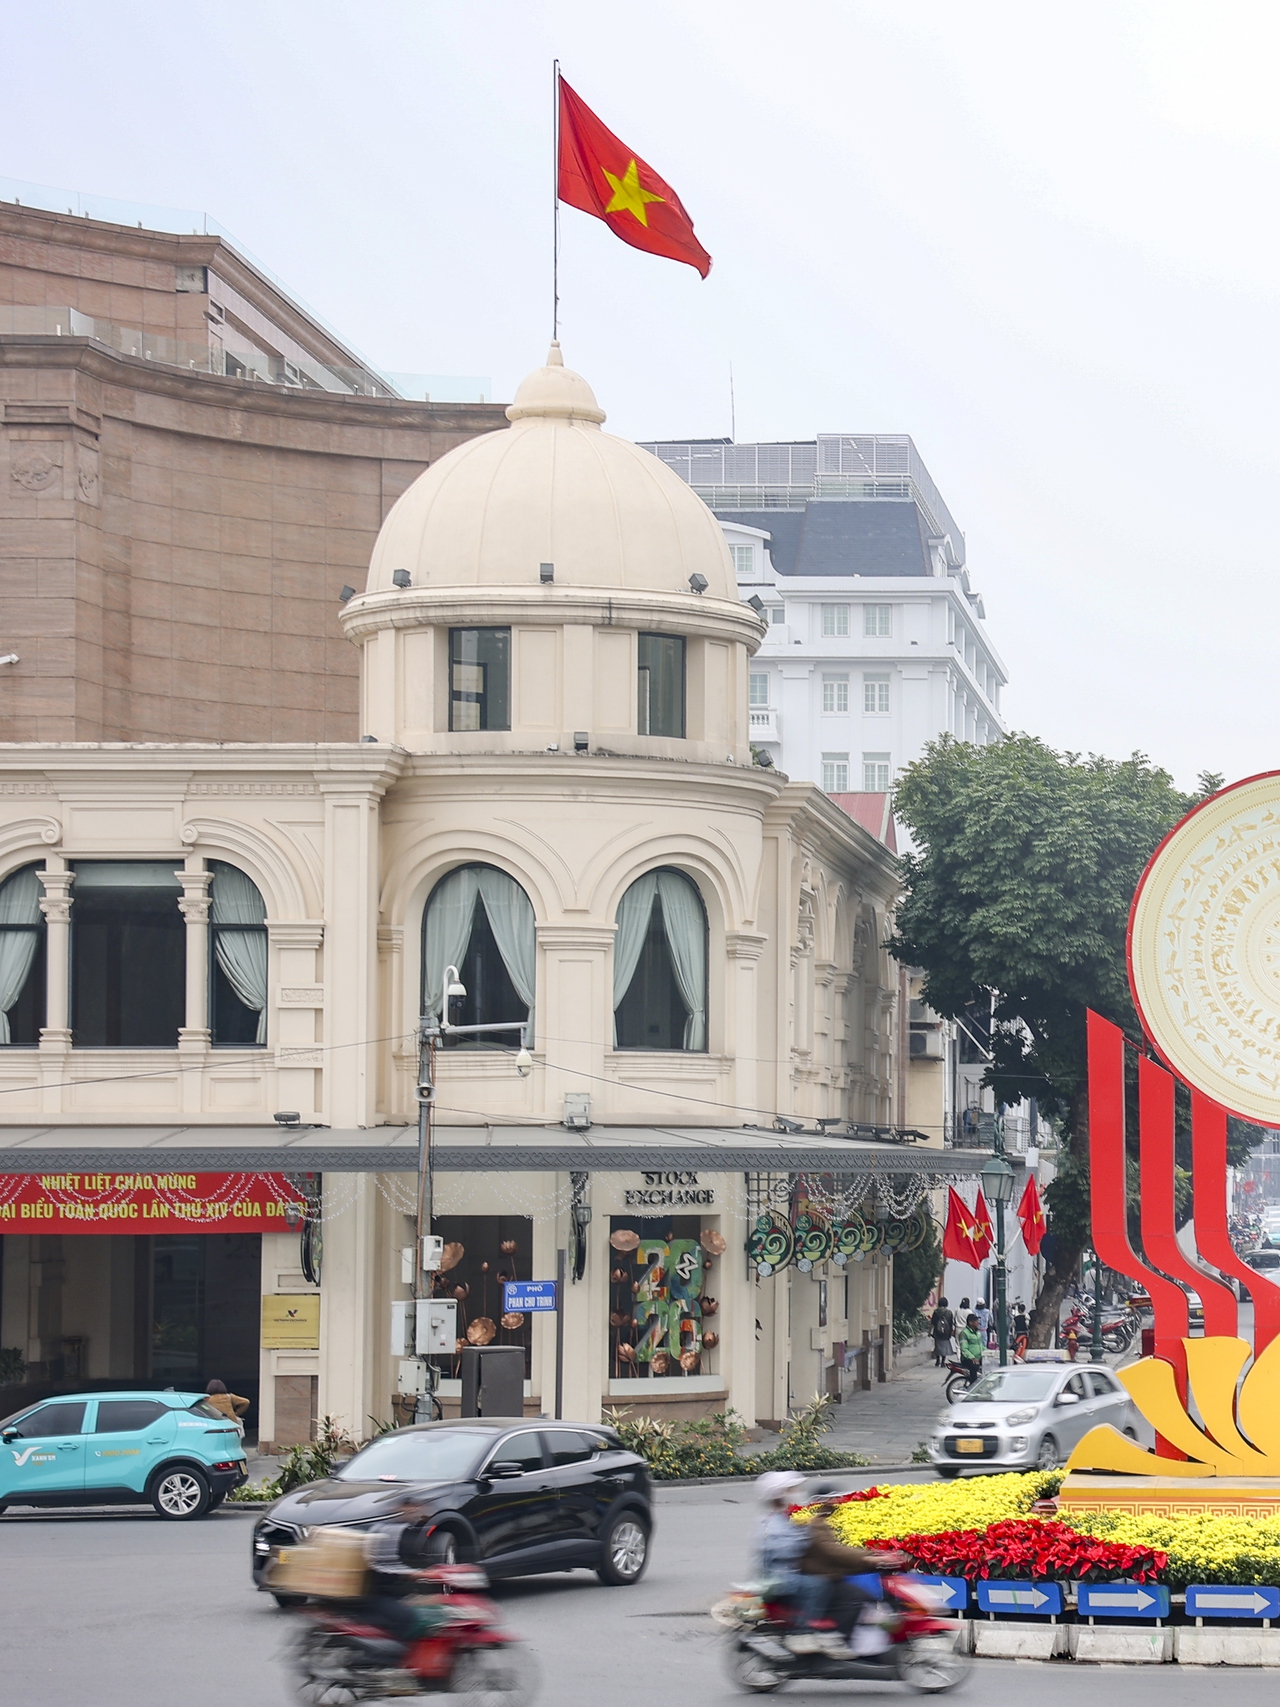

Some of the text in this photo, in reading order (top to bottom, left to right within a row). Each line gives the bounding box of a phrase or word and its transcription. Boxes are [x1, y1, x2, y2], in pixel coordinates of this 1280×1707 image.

[42, 1173, 196, 1193] NHIỆT LIỆT CHÀO MỪNG
[645, 1171, 699, 1186] STOCK
[625, 1189, 715, 1205] EXCHANGE
[0, 1203, 16, 1221] ẠI
[21, 1197, 53, 1218] BIỂU
[59, 1200, 95, 1218] TOÀN
[99, 1199, 138, 1220] QUỐC
[143, 1199, 169, 1218] LẦN
[173, 1200, 201, 1218] THỨ
[205, 1202, 229, 1218] XIV
[233, 1198, 262, 1217] CỦA
[526, 1283, 544, 1292] PHỐ
[508, 1297, 524, 1308] PHAN
[536, 1296, 553, 1307] TRINH
